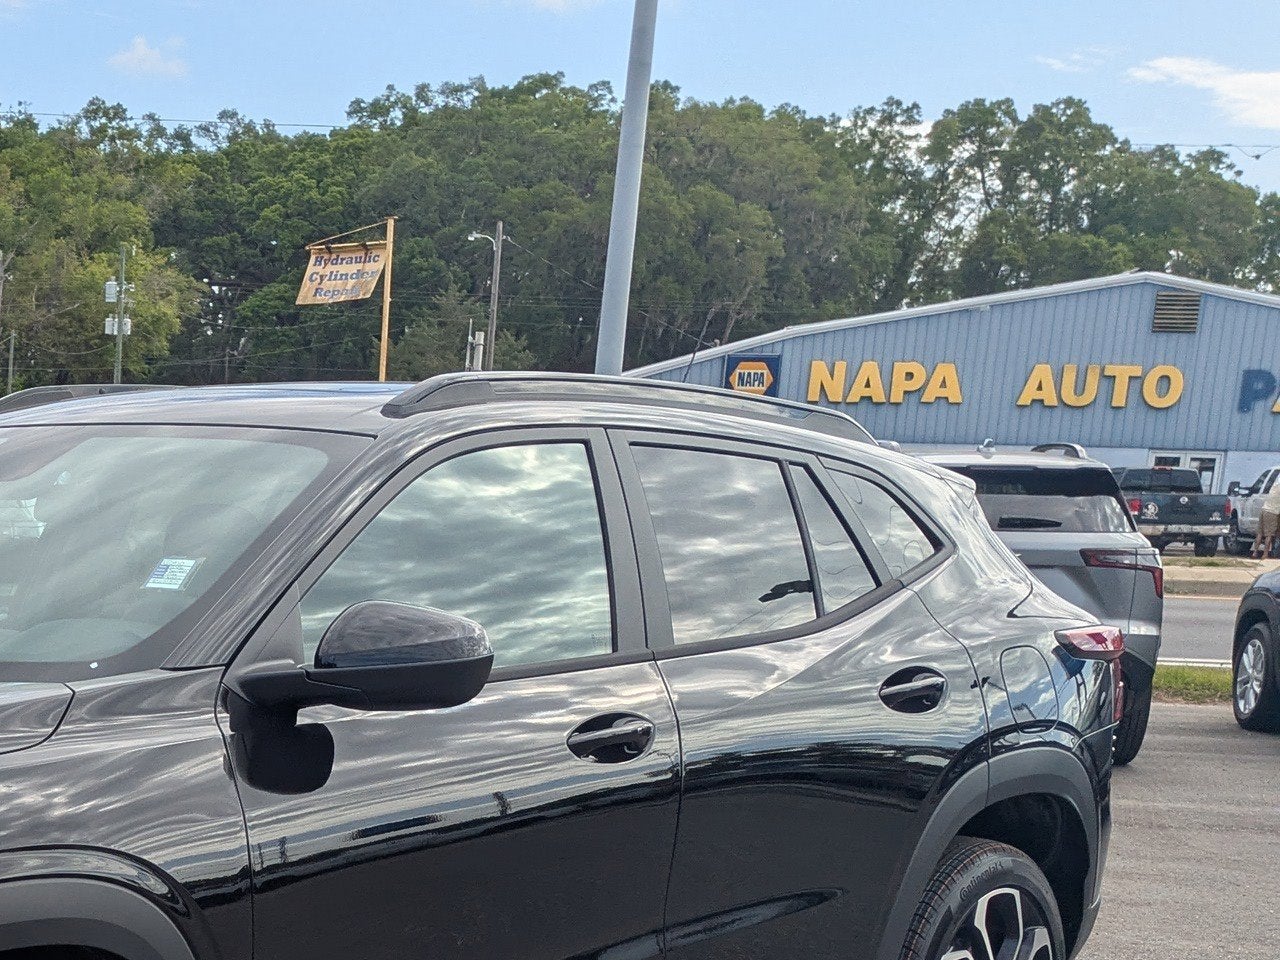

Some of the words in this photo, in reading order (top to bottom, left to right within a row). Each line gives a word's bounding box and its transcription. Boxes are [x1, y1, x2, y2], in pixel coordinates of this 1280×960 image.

[313, 251, 381, 269] Hydraulic
[308, 269, 379, 285] Cylinder
[737, 371, 765, 388] NAPA
[807, 360, 963, 404] NAPA
[1016, 362, 1185, 409] AUTO
[1237, 369, 1280, 415] P
